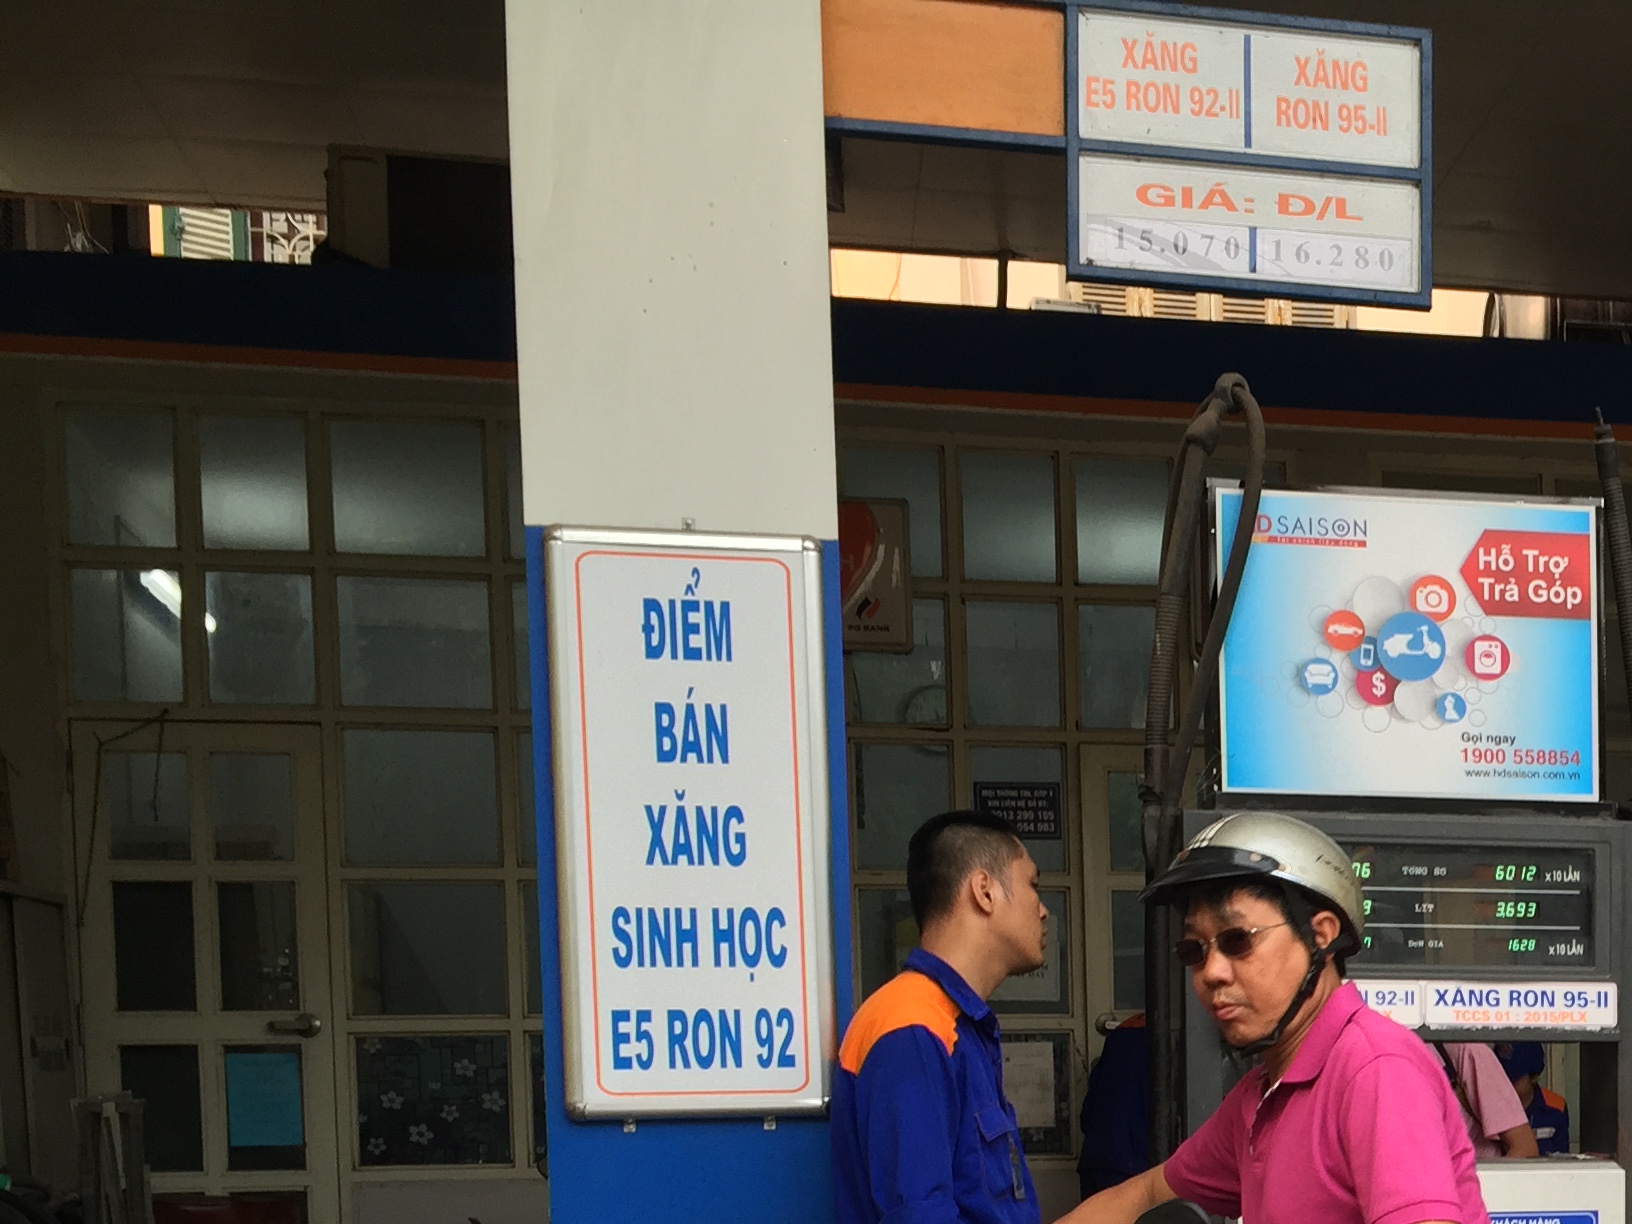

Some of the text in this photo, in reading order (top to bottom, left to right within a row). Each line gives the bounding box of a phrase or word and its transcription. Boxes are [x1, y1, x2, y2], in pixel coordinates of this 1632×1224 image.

[1121, 31, 1199, 74] XĂNG
[1294, 48, 1369, 93] XĂNG
[1085, 76, 1240, 119] E5 RON 92-II
[1276, 96, 1388, 136] RON 95-II
[1135, 182, 1363, 222] GIÁ: Đ/L
[1114, 226, 1240, 260] 15.070
[1271, 238, 1393, 271] 16.280
[1277, 515, 1367, 538] SAISON
[1478, 544, 1569, 575] Hỗ Trợ
[1478, 576, 1582, 609] Trả Góp
[642, 566, 733, 662] ĐIỂM
[654, 687, 729, 764] BÁN
[1461, 732, 1516, 747] Gọi ngay
[1461, 747, 1581, 766] 1900 558854
[644, 789, 747, 866] XĂNG
[612, 906, 788, 982] SINH HỌC
[1375, 990, 1415, 1006] 92-II
[1435, 985, 1609, 1008] XĂNG RON 95-II
[1453, 1010, 1490, 1022] TCCS
[612, 1009, 796, 1071] E5 RON 92
